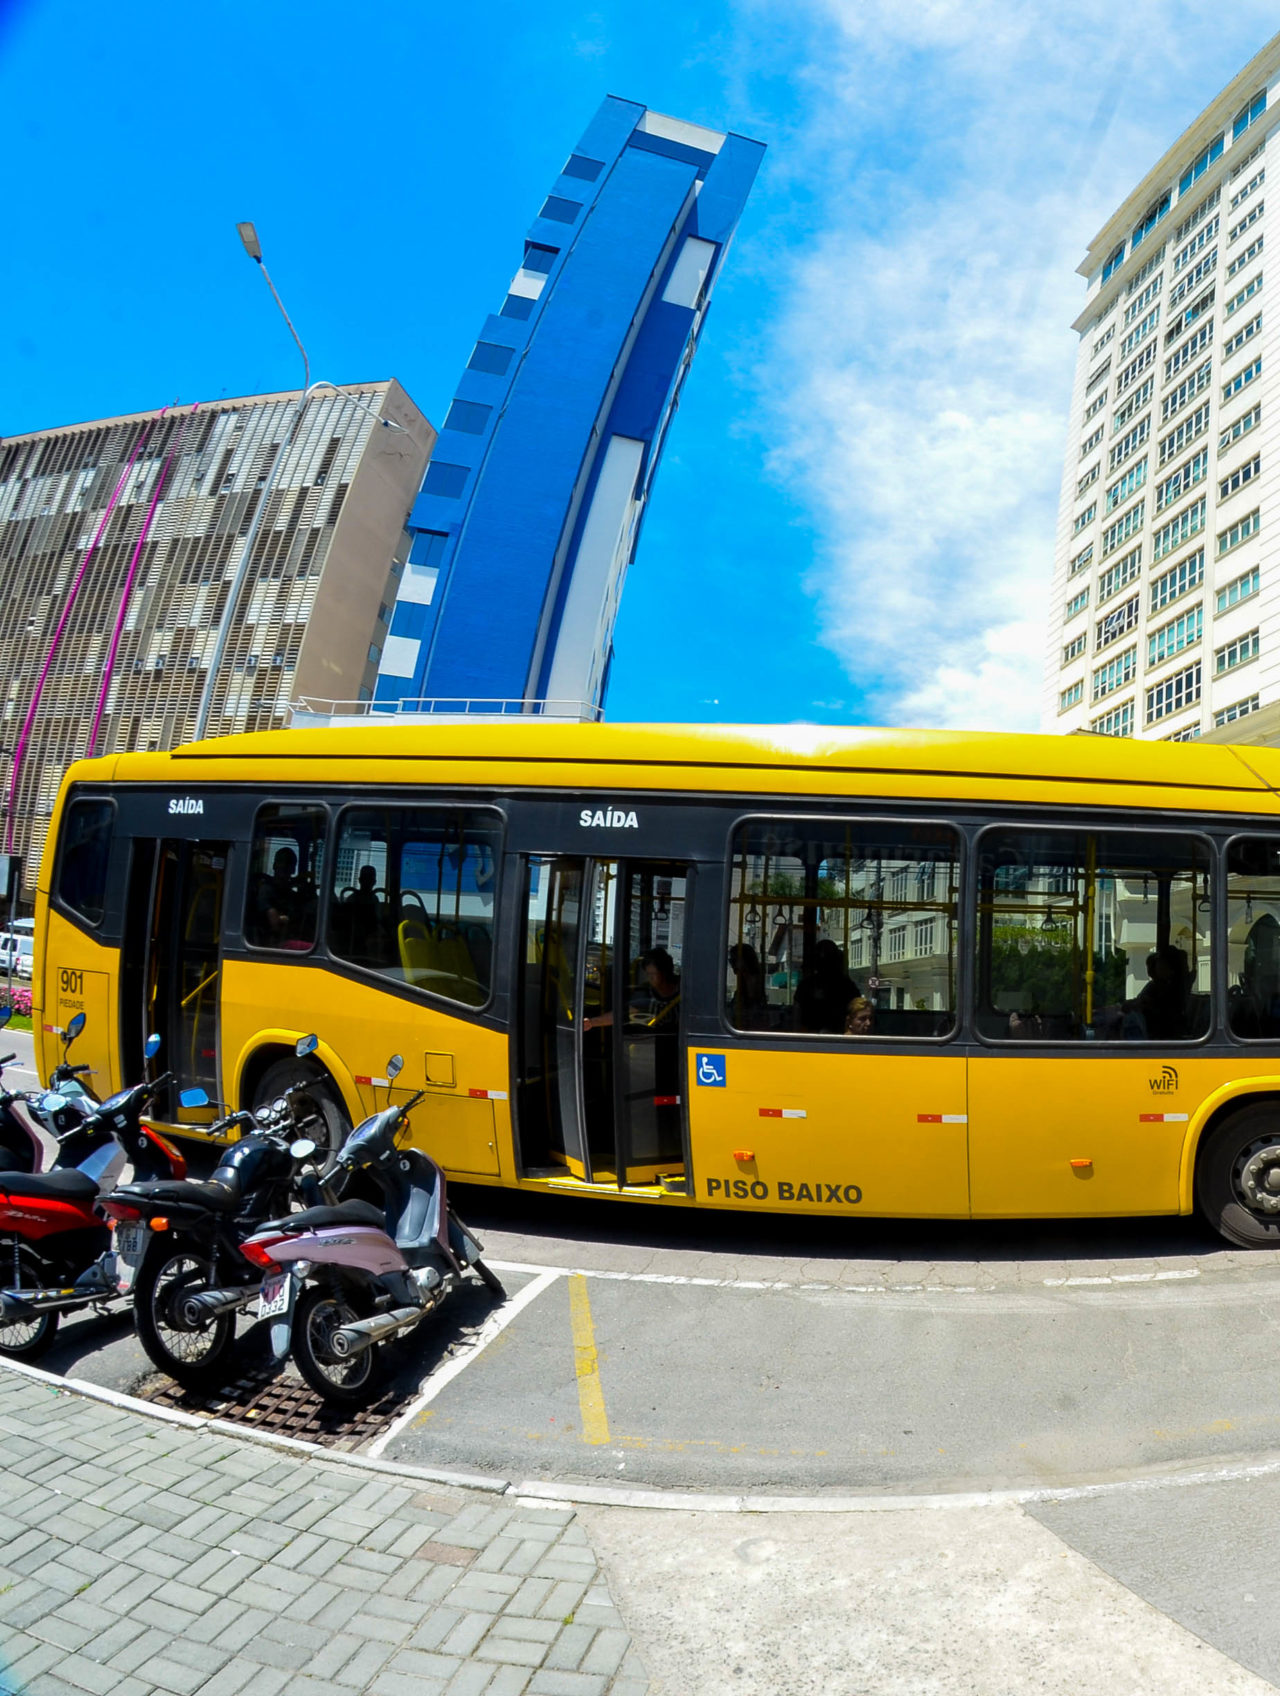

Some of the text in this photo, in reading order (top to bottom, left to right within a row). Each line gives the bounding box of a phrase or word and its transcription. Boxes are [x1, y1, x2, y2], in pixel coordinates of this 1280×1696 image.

[168, 796, 204, 814] SAÍDA
[579, 806, 639, 828] SAÍDA
[61, 970, 83, 995] 901
[706, 1178, 863, 1204] PISO BAIXO
